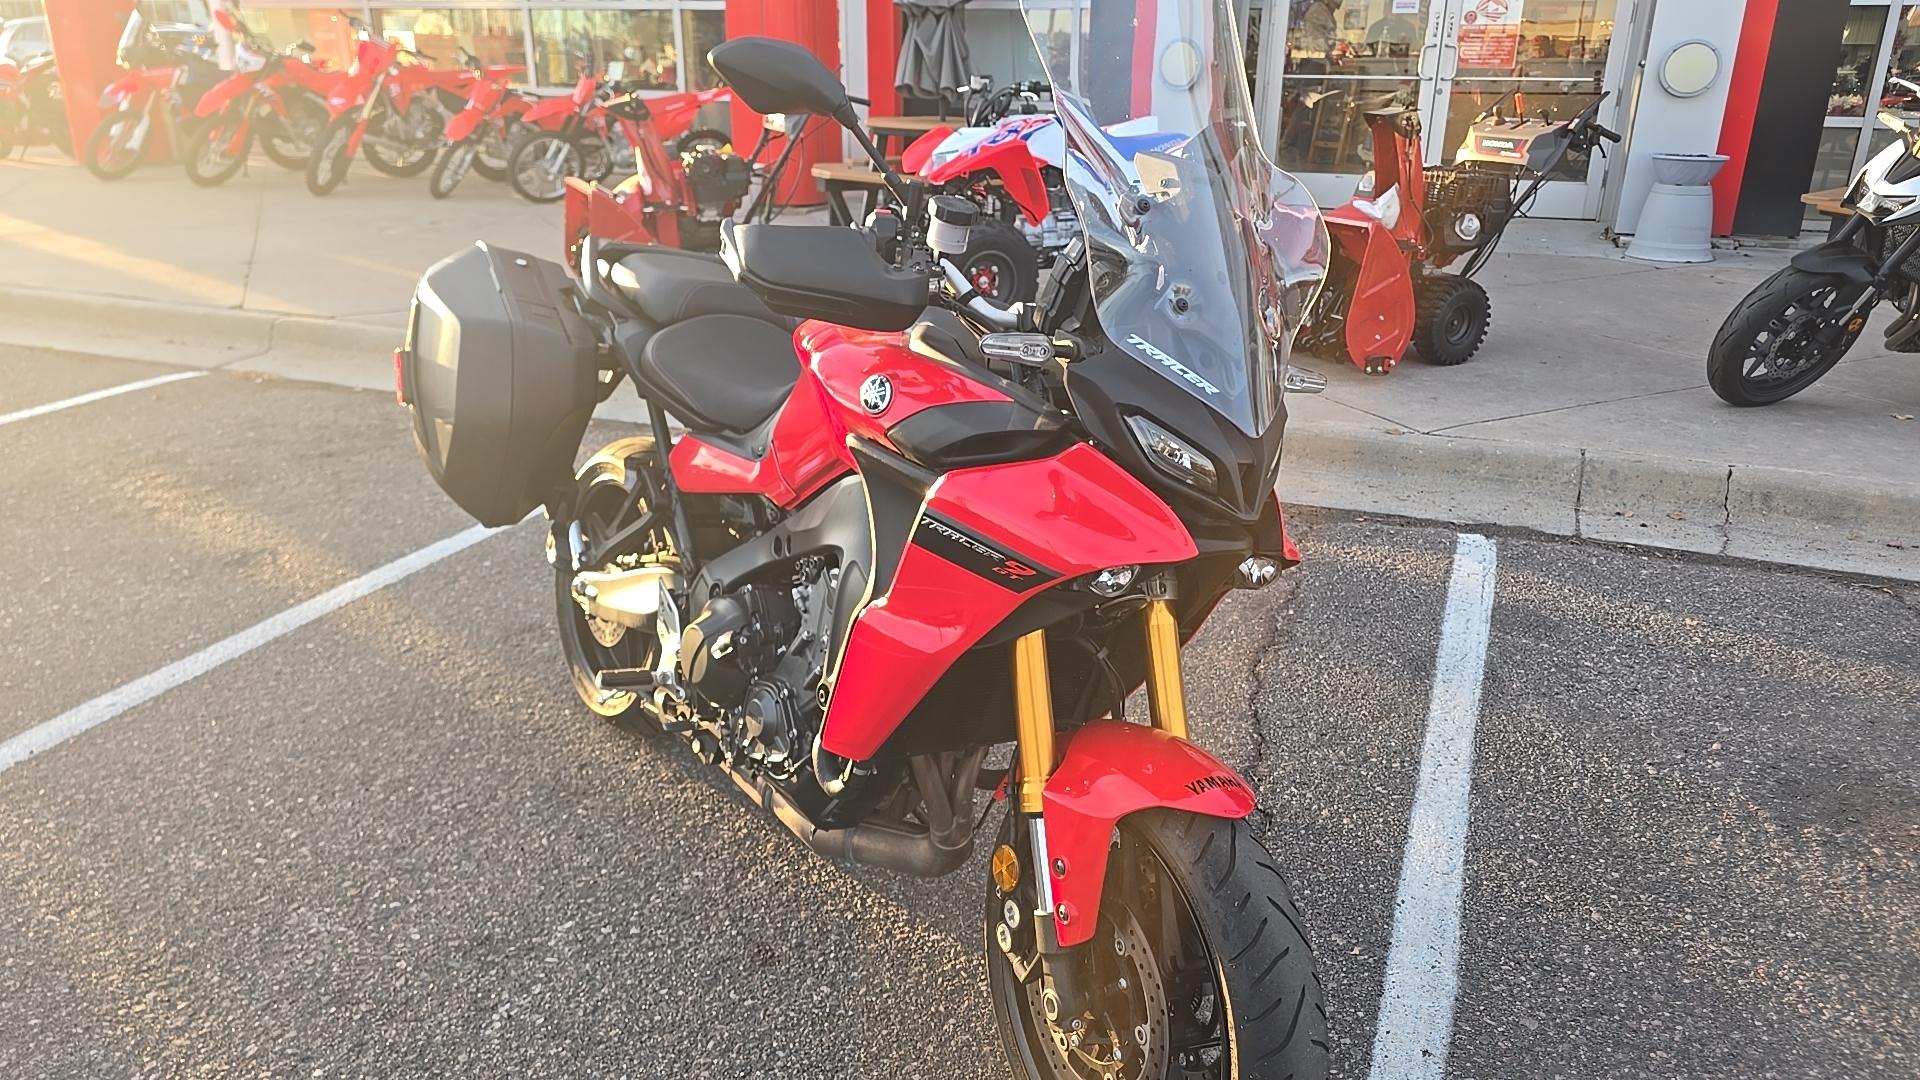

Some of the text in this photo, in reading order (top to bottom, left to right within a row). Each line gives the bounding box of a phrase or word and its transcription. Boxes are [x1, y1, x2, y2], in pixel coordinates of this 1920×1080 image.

[1481, 139, 1515, 149] HONDA
[1126, 333, 1220, 395] TRACER
[920, 515, 1037, 576] TRACER 9
